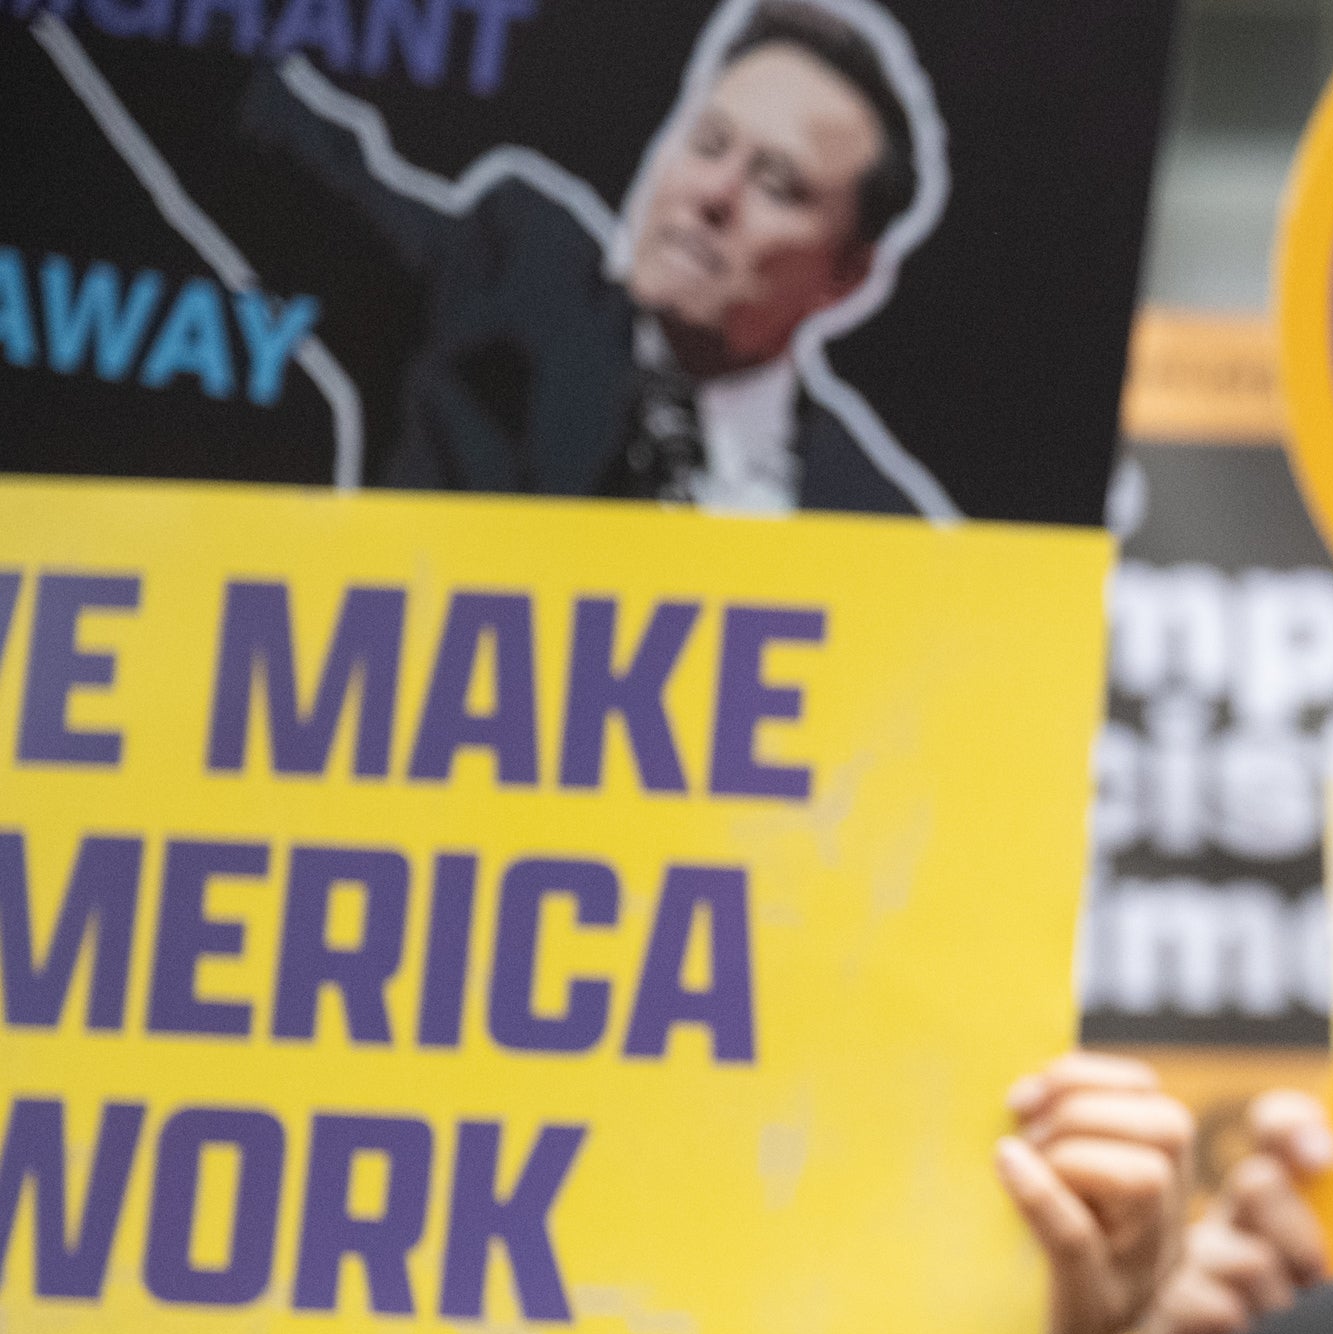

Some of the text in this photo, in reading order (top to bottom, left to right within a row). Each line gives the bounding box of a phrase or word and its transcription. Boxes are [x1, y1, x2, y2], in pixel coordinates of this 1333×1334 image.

[0, 566, 831, 806] E MAKE
[0, 828, 759, 1067] MERICA
